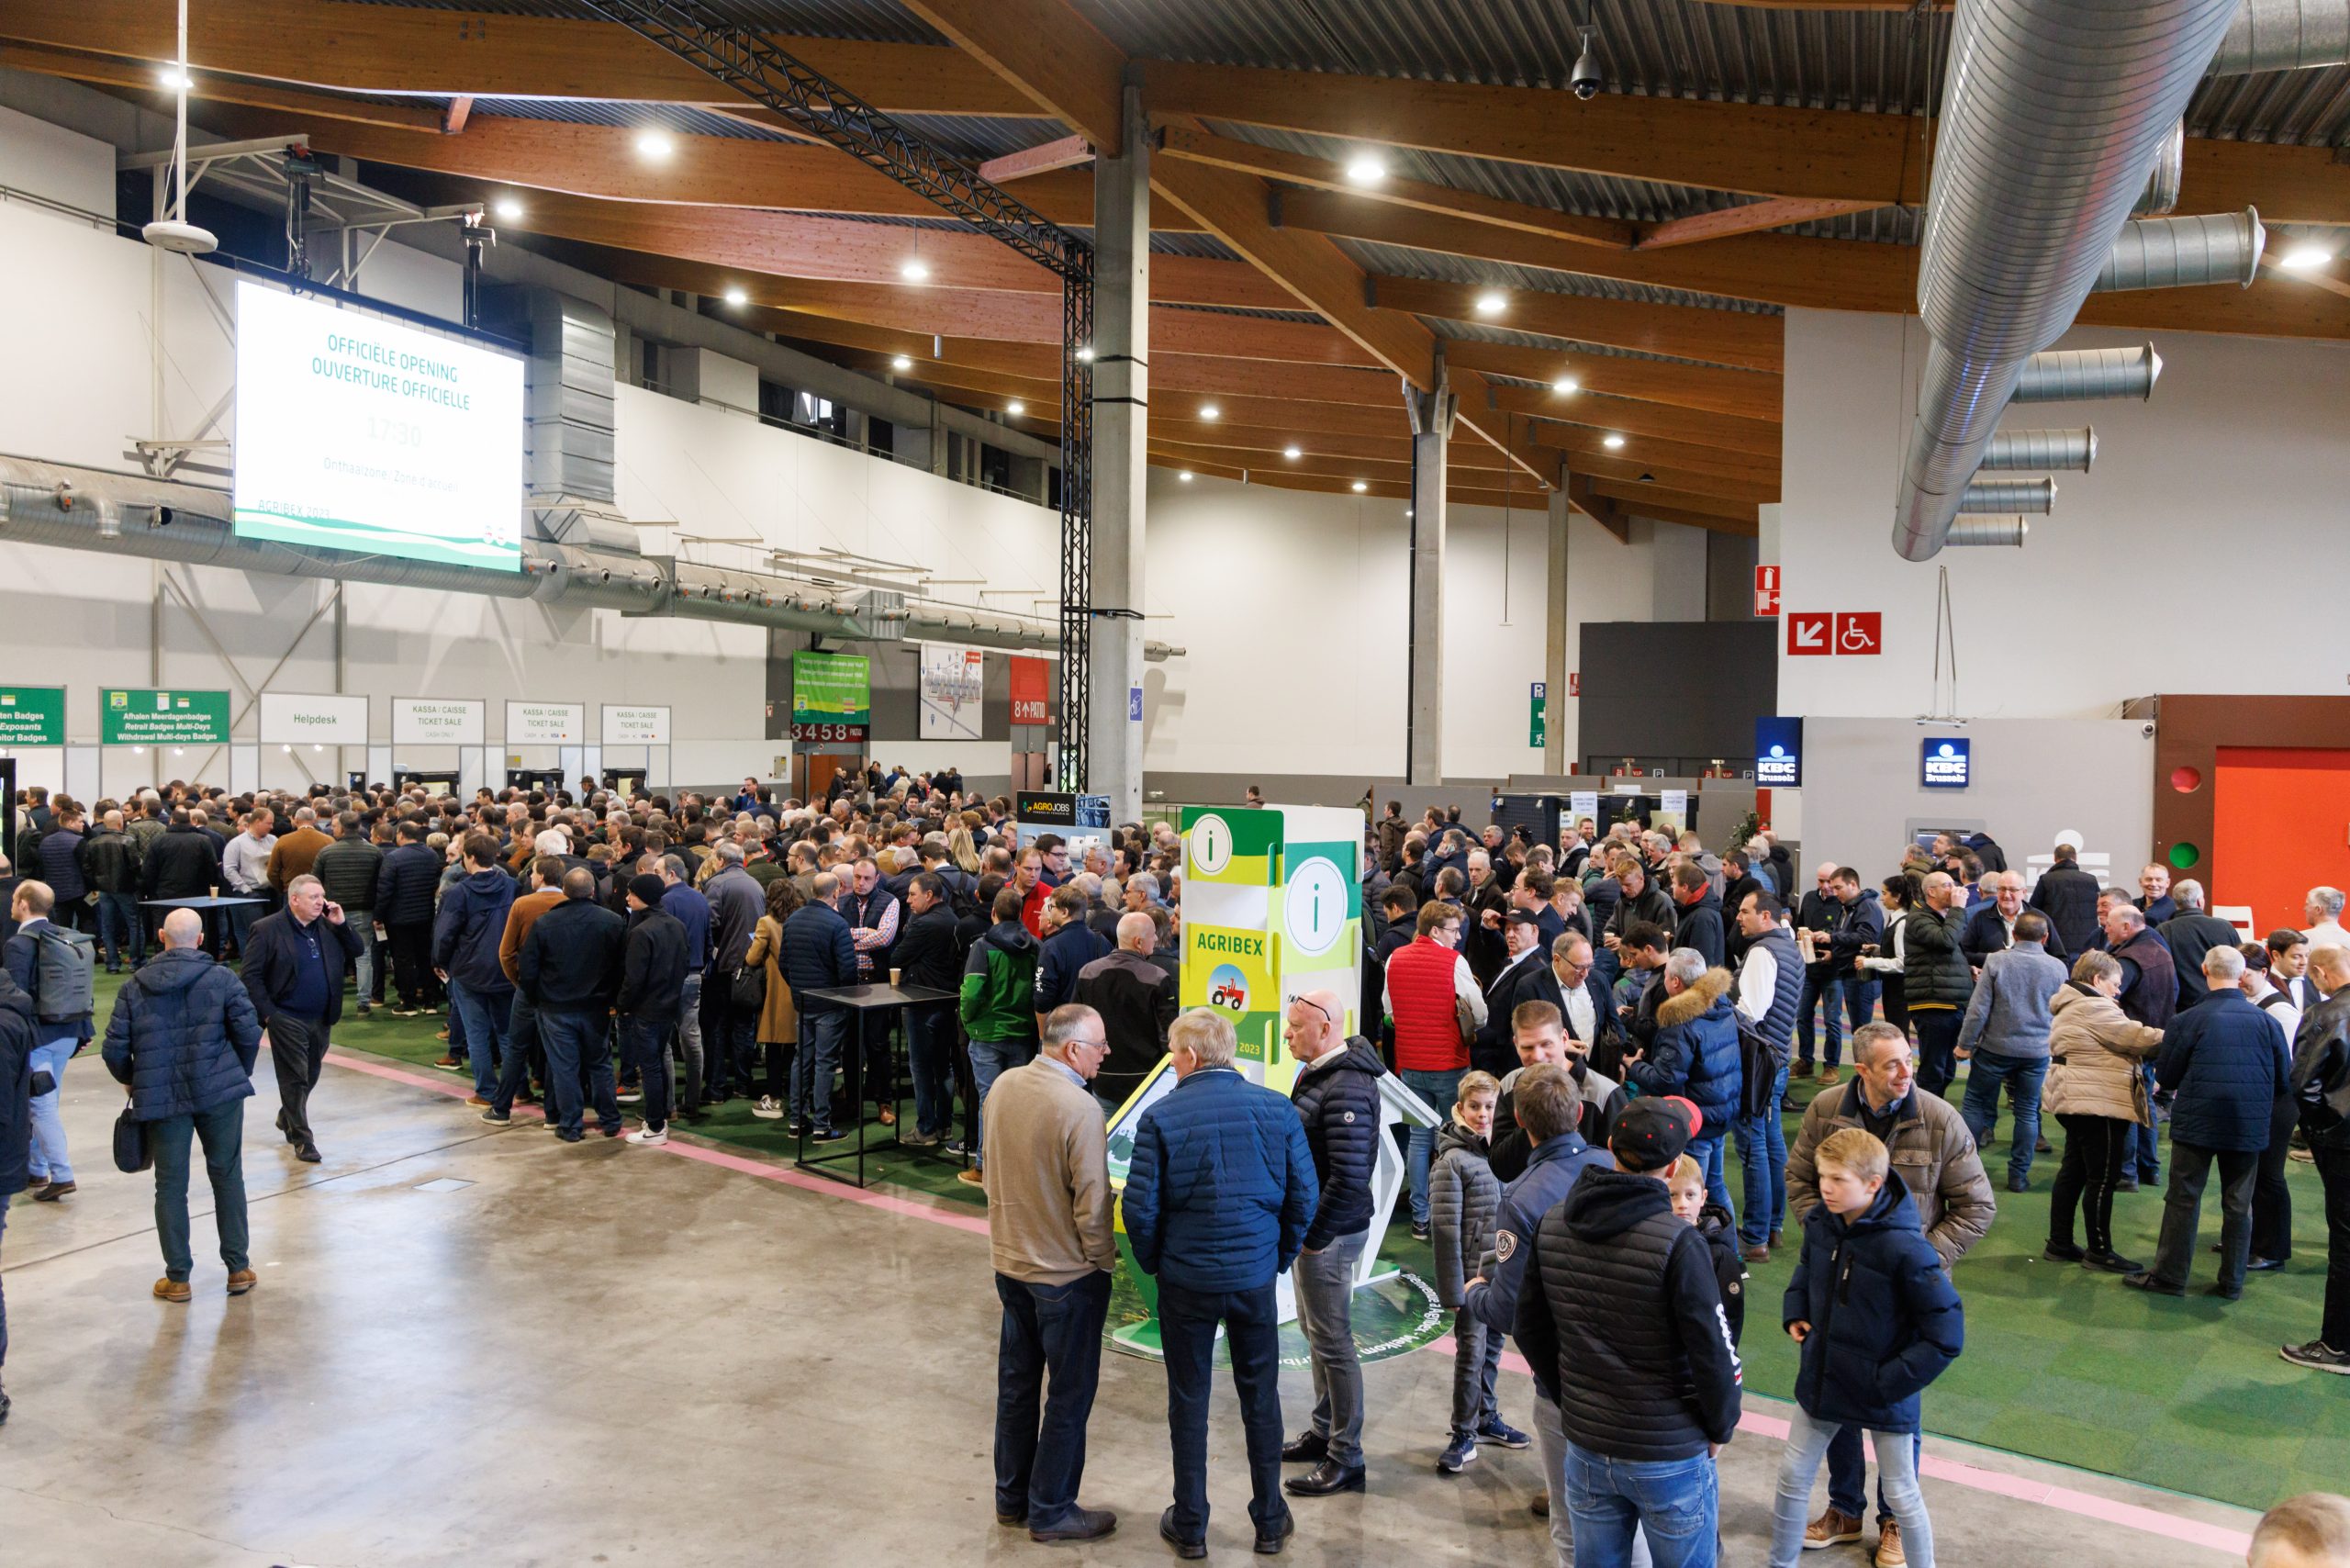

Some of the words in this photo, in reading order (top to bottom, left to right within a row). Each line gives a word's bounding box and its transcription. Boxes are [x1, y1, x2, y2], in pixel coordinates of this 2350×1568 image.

[328, 334, 396, 367] OFFICIËLE
[400, 353, 458, 383] OPENING
[312, 357, 397, 393] OUVERTURE
[402, 380, 470, 410] OFFICIELLE
[367, 416, 422, 448] 17:30
[394, 469, 418, 486] Zone
[257, 498, 303, 518] AGRIBEX
[442, 706, 466, 714] CAISSE
[1014, 700, 1020, 718] 8
[1030, 701, 1045, 719] PATIO
[15, 711, 44, 722] Badges
[123, 712, 150, 721] Afhalen
[151, 712, 212, 722] Meerdagenbadges
[294, 713, 337, 725] Helpdesk
[0, 722, 41, 732] Exposants
[149, 722, 174, 732] Badges
[550, 720, 565, 728] SALE
[118, 733, 156, 741] Withdrawal
[193, 733, 218, 742] Badges
[791, 723, 802, 740] 3
[806, 723, 817, 740] 4
[821, 724, 832, 740] 5
[835, 724, 846, 741] 8
[17, 734, 47, 743] Badges
[1758, 763, 1796, 773] KBC
[1926, 762, 1966, 774] KBC
[1758, 773, 1795, 781] Brussels
[1926, 774, 1965, 783] Brussels
[1033, 801, 1070, 812] AGROJOBS
[1197, 933, 1263, 957] AGRIBEX
[1239, 1042, 1260, 1055] 2023
[1415, 1307, 1445, 1333] Agribex
[1360, 1334, 1419, 1355] Welkom
